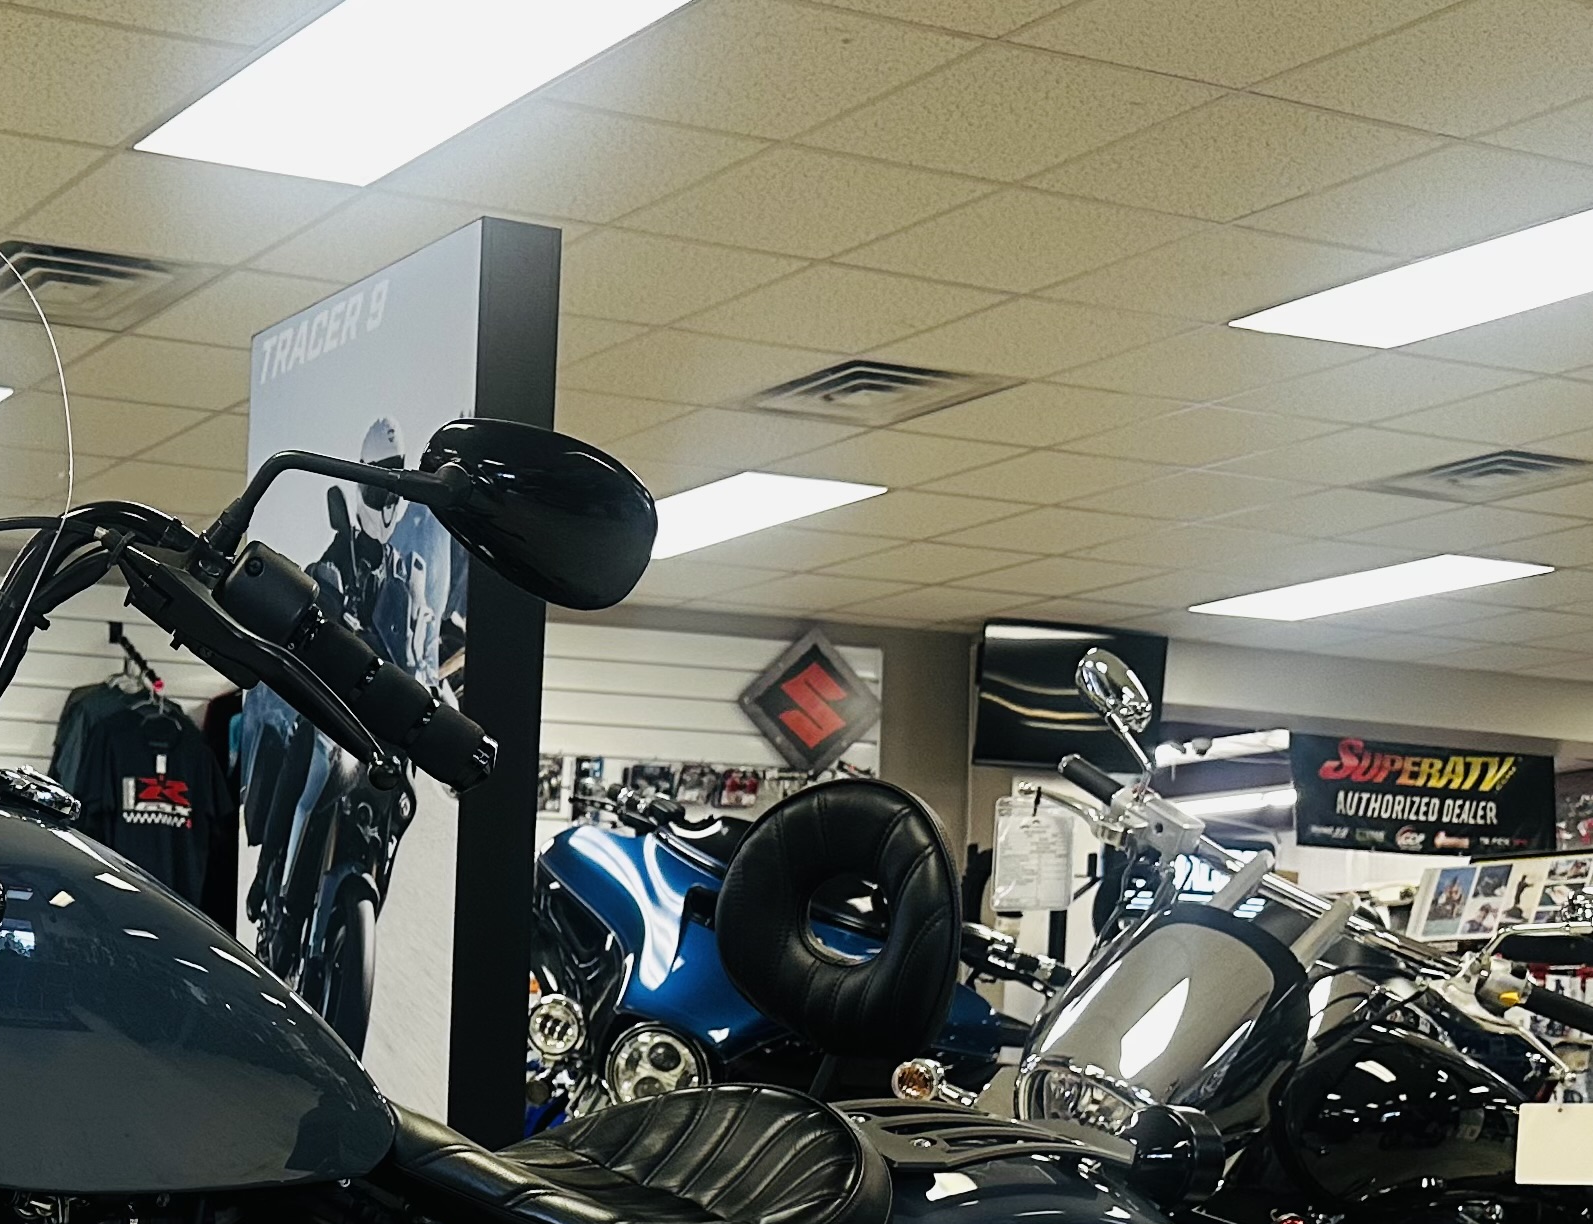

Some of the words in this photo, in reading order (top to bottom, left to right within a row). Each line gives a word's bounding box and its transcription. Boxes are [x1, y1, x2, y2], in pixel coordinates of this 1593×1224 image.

[260, 292, 364, 385] TRACER
[366, 279, 391, 333] 9
[1336, 789, 1439, 823] AUTHORIZED
[1441, 798, 1499, 825] DEALER
